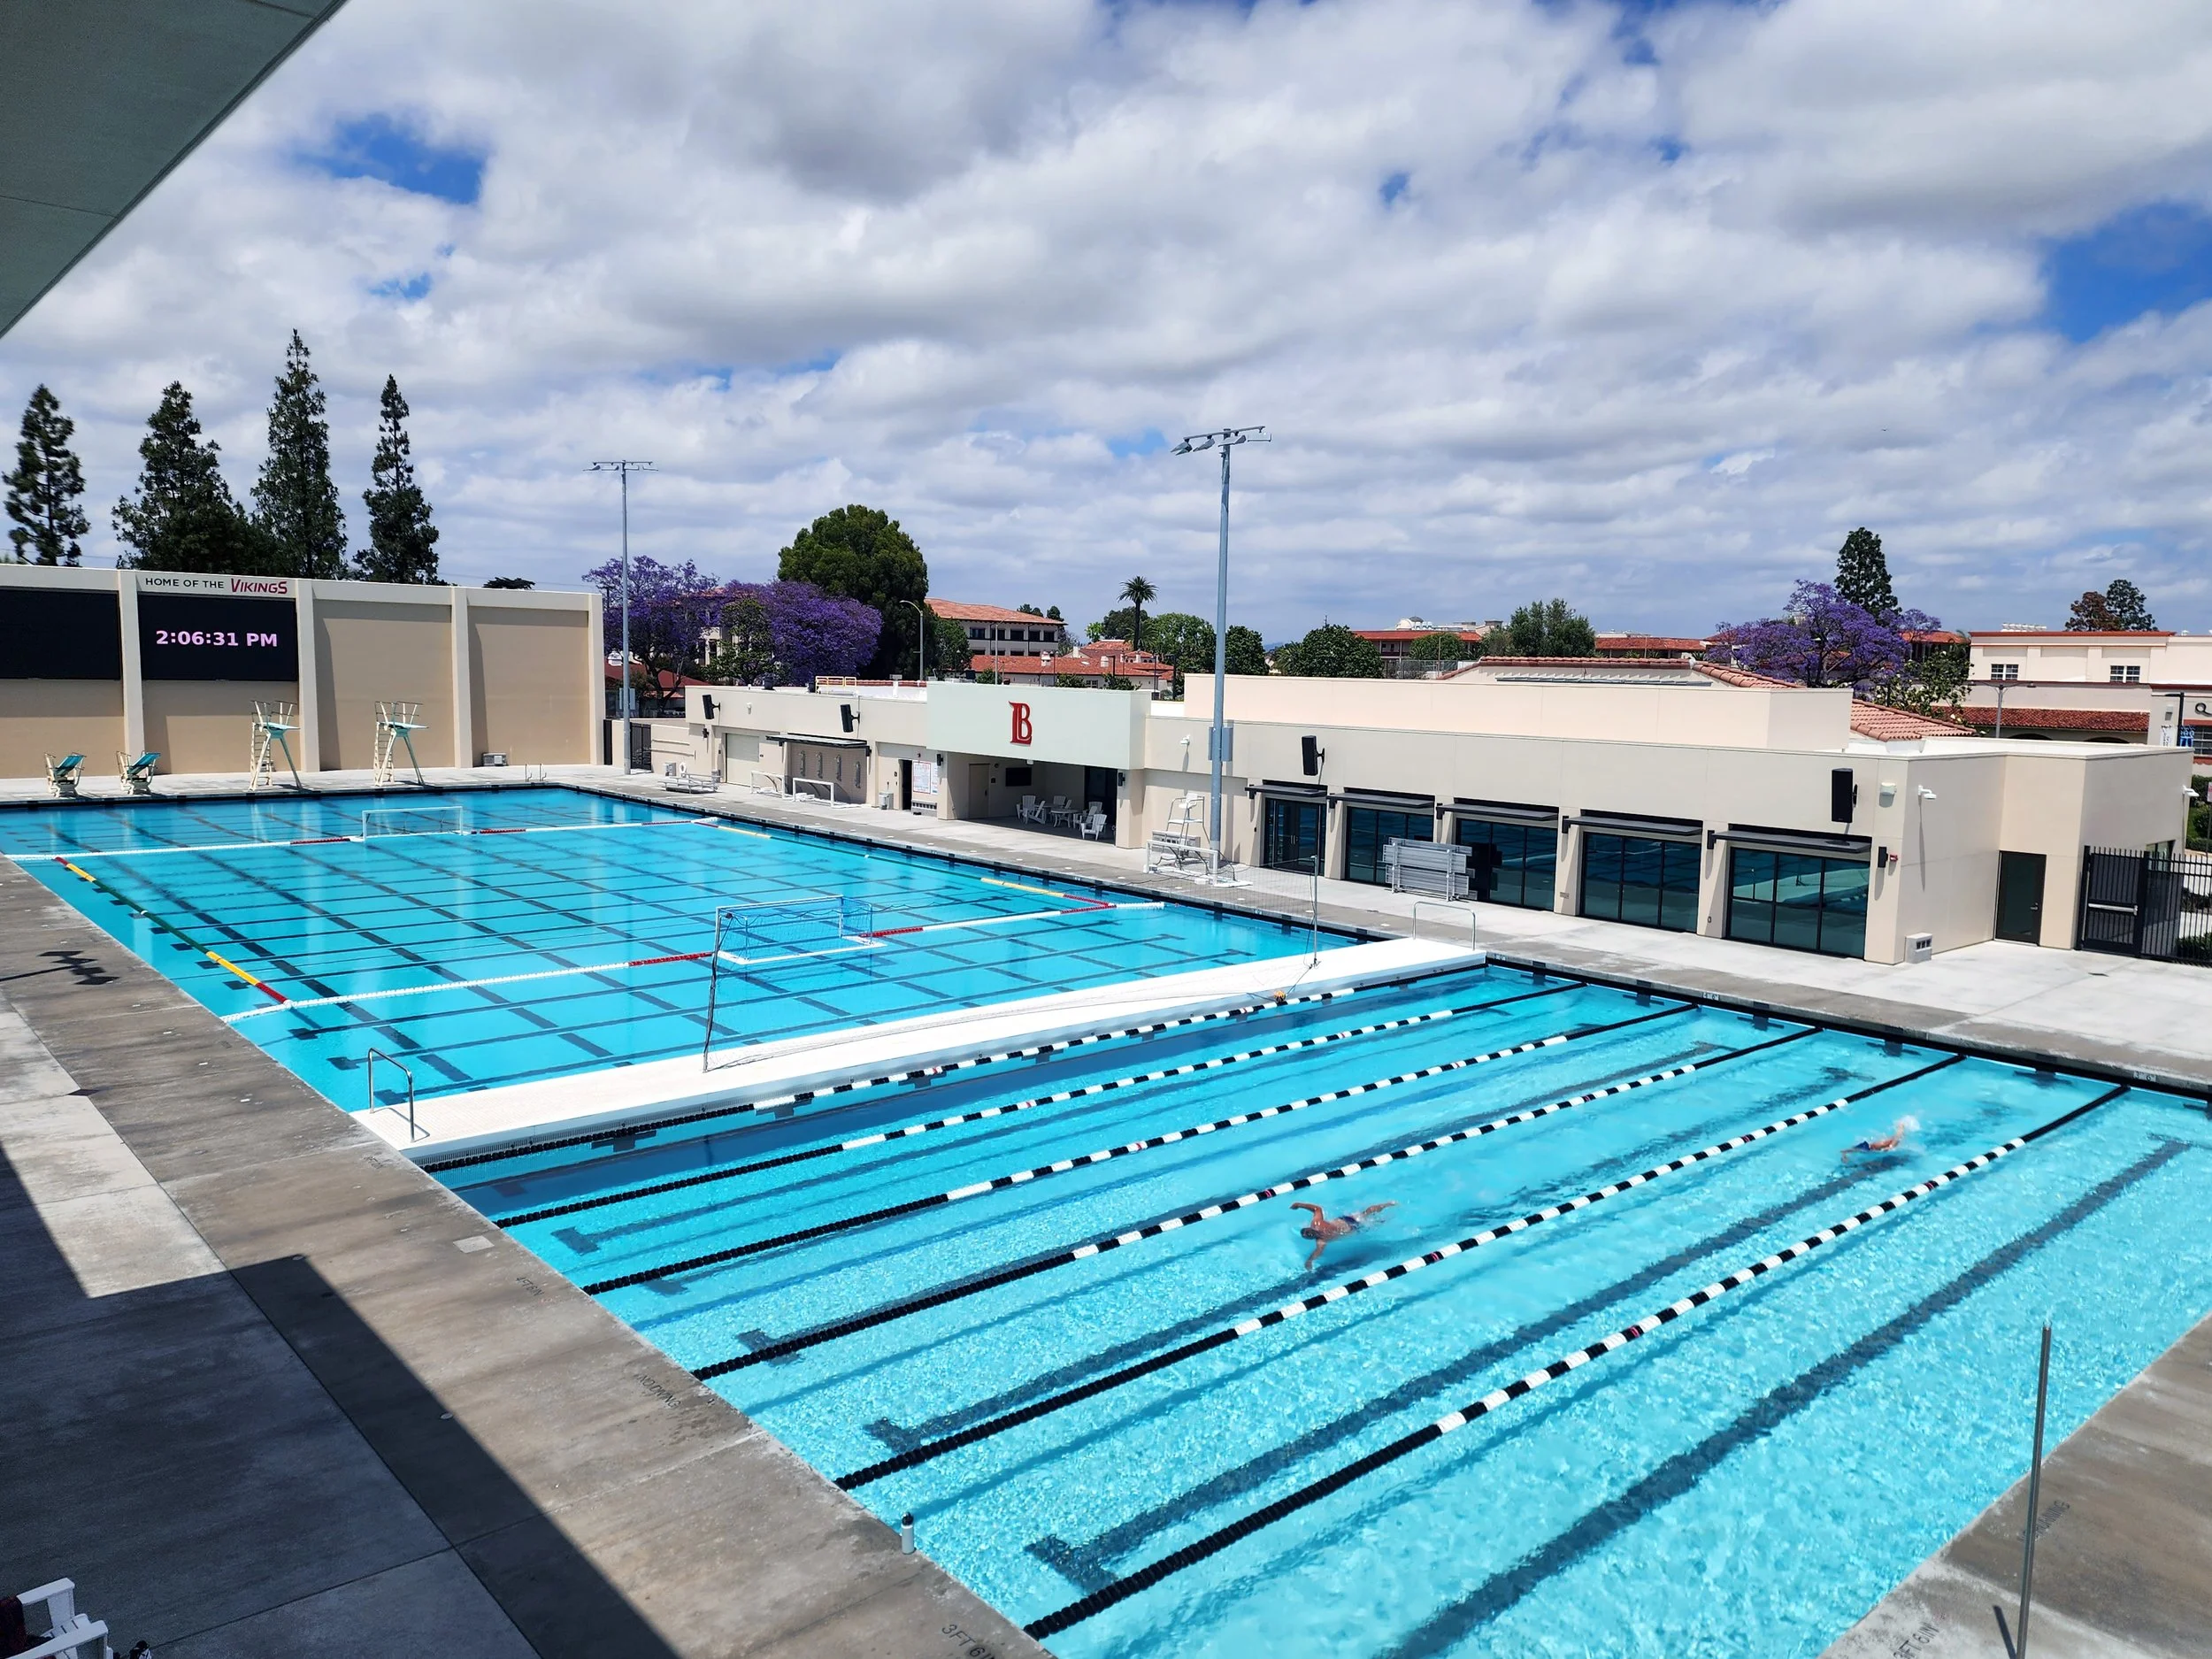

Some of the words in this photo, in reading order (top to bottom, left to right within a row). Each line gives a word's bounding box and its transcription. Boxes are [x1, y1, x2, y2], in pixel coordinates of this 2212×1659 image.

[145, 578, 180, 587] HOME
[231, 578, 288, 595] VIKINGS
[156, 630, 239, 646] 2:06:31
[246, 633, 278, 647] PM
[941, 1624, 977, 1647] 3FT
